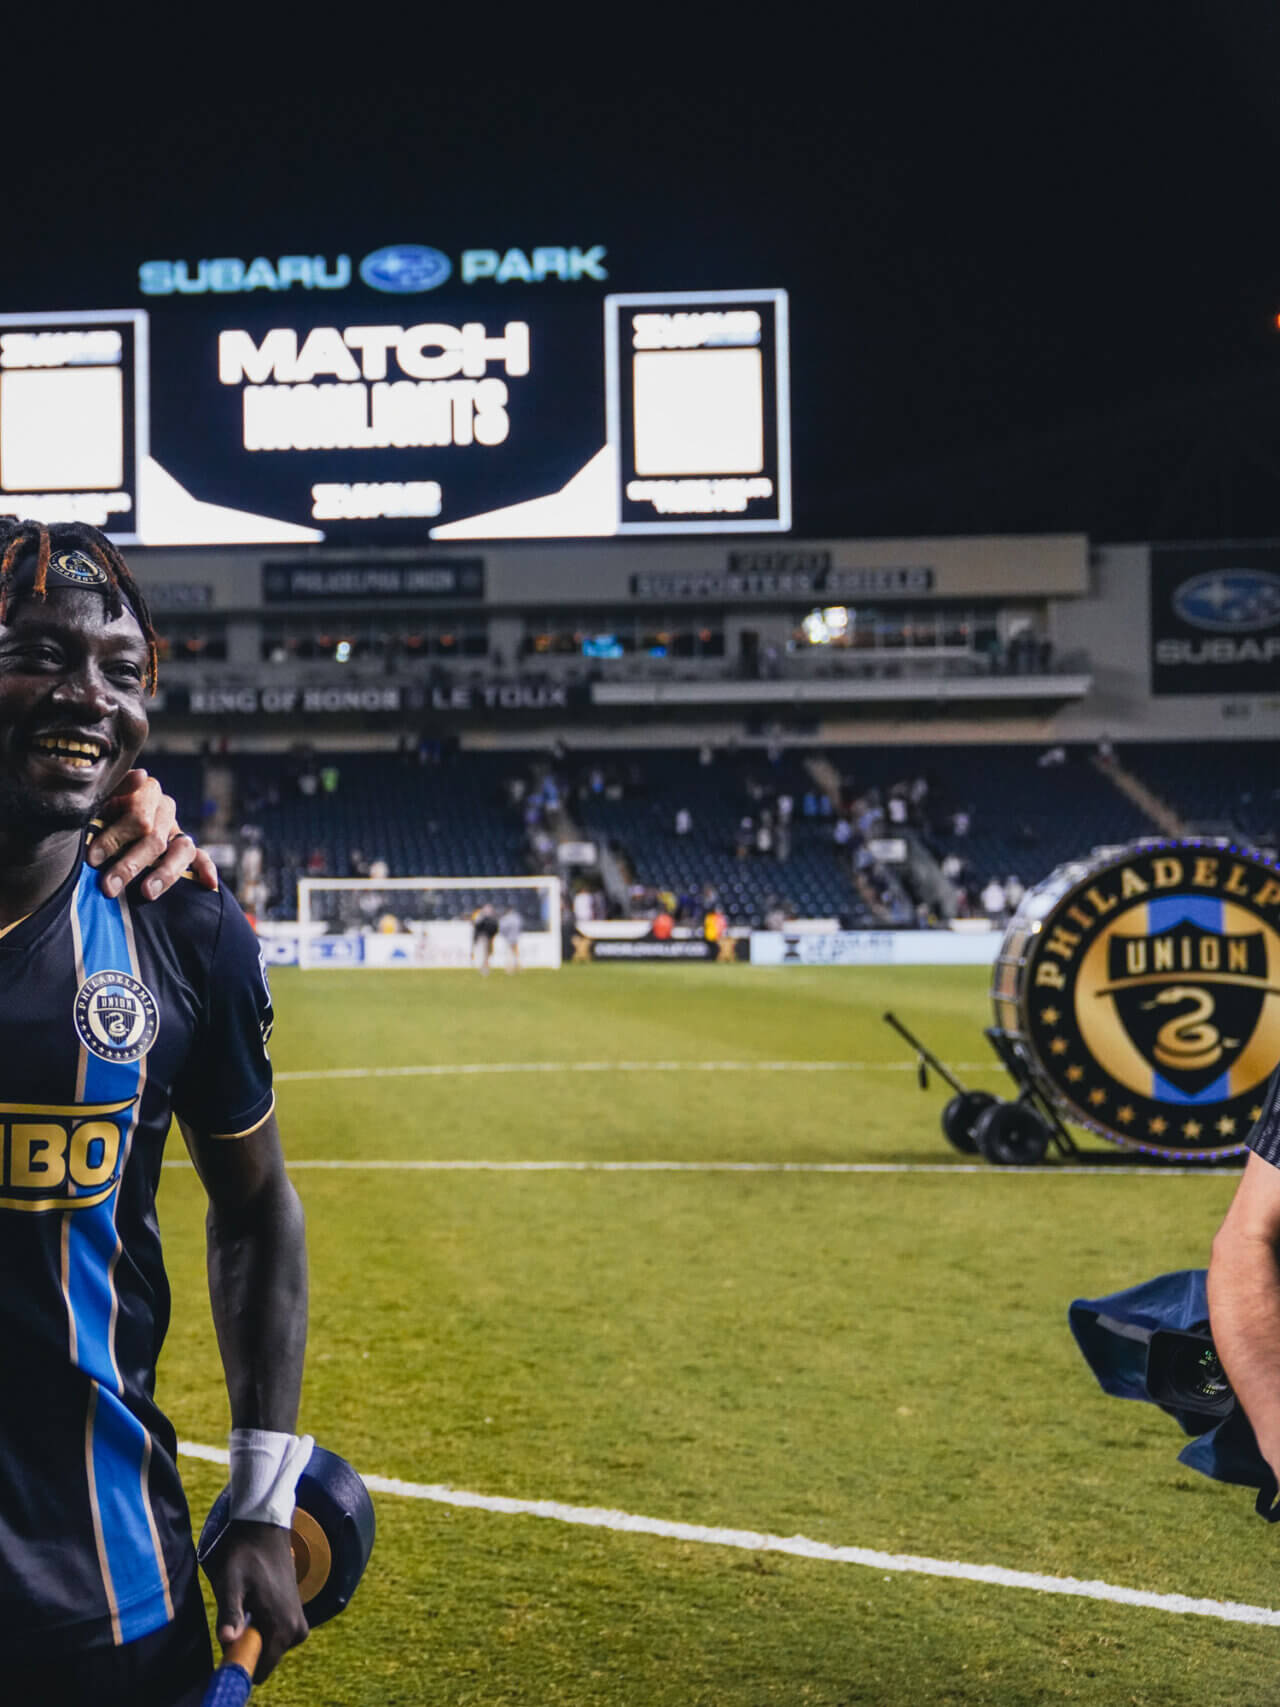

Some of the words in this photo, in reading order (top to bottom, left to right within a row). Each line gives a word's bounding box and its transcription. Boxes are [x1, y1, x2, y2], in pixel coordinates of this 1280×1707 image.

[139, 254, 351, 295] SUBARU
[461, 244, 608, 284] PARK
[218, 320, 530, 384] MATCH
[190, 690, 258, 713] RING
[261, 689, 296, 712] OF
[303, 688, 401, 711] HONOR
[431, 686, 472, 710] LE
[483, 685, 568, 709] TOUX
[1126, 936, 1247, 975] UNION
[78, 974, 154, 1015] PHILADELPHIA
[101, 997, 132, 1009] UNION
